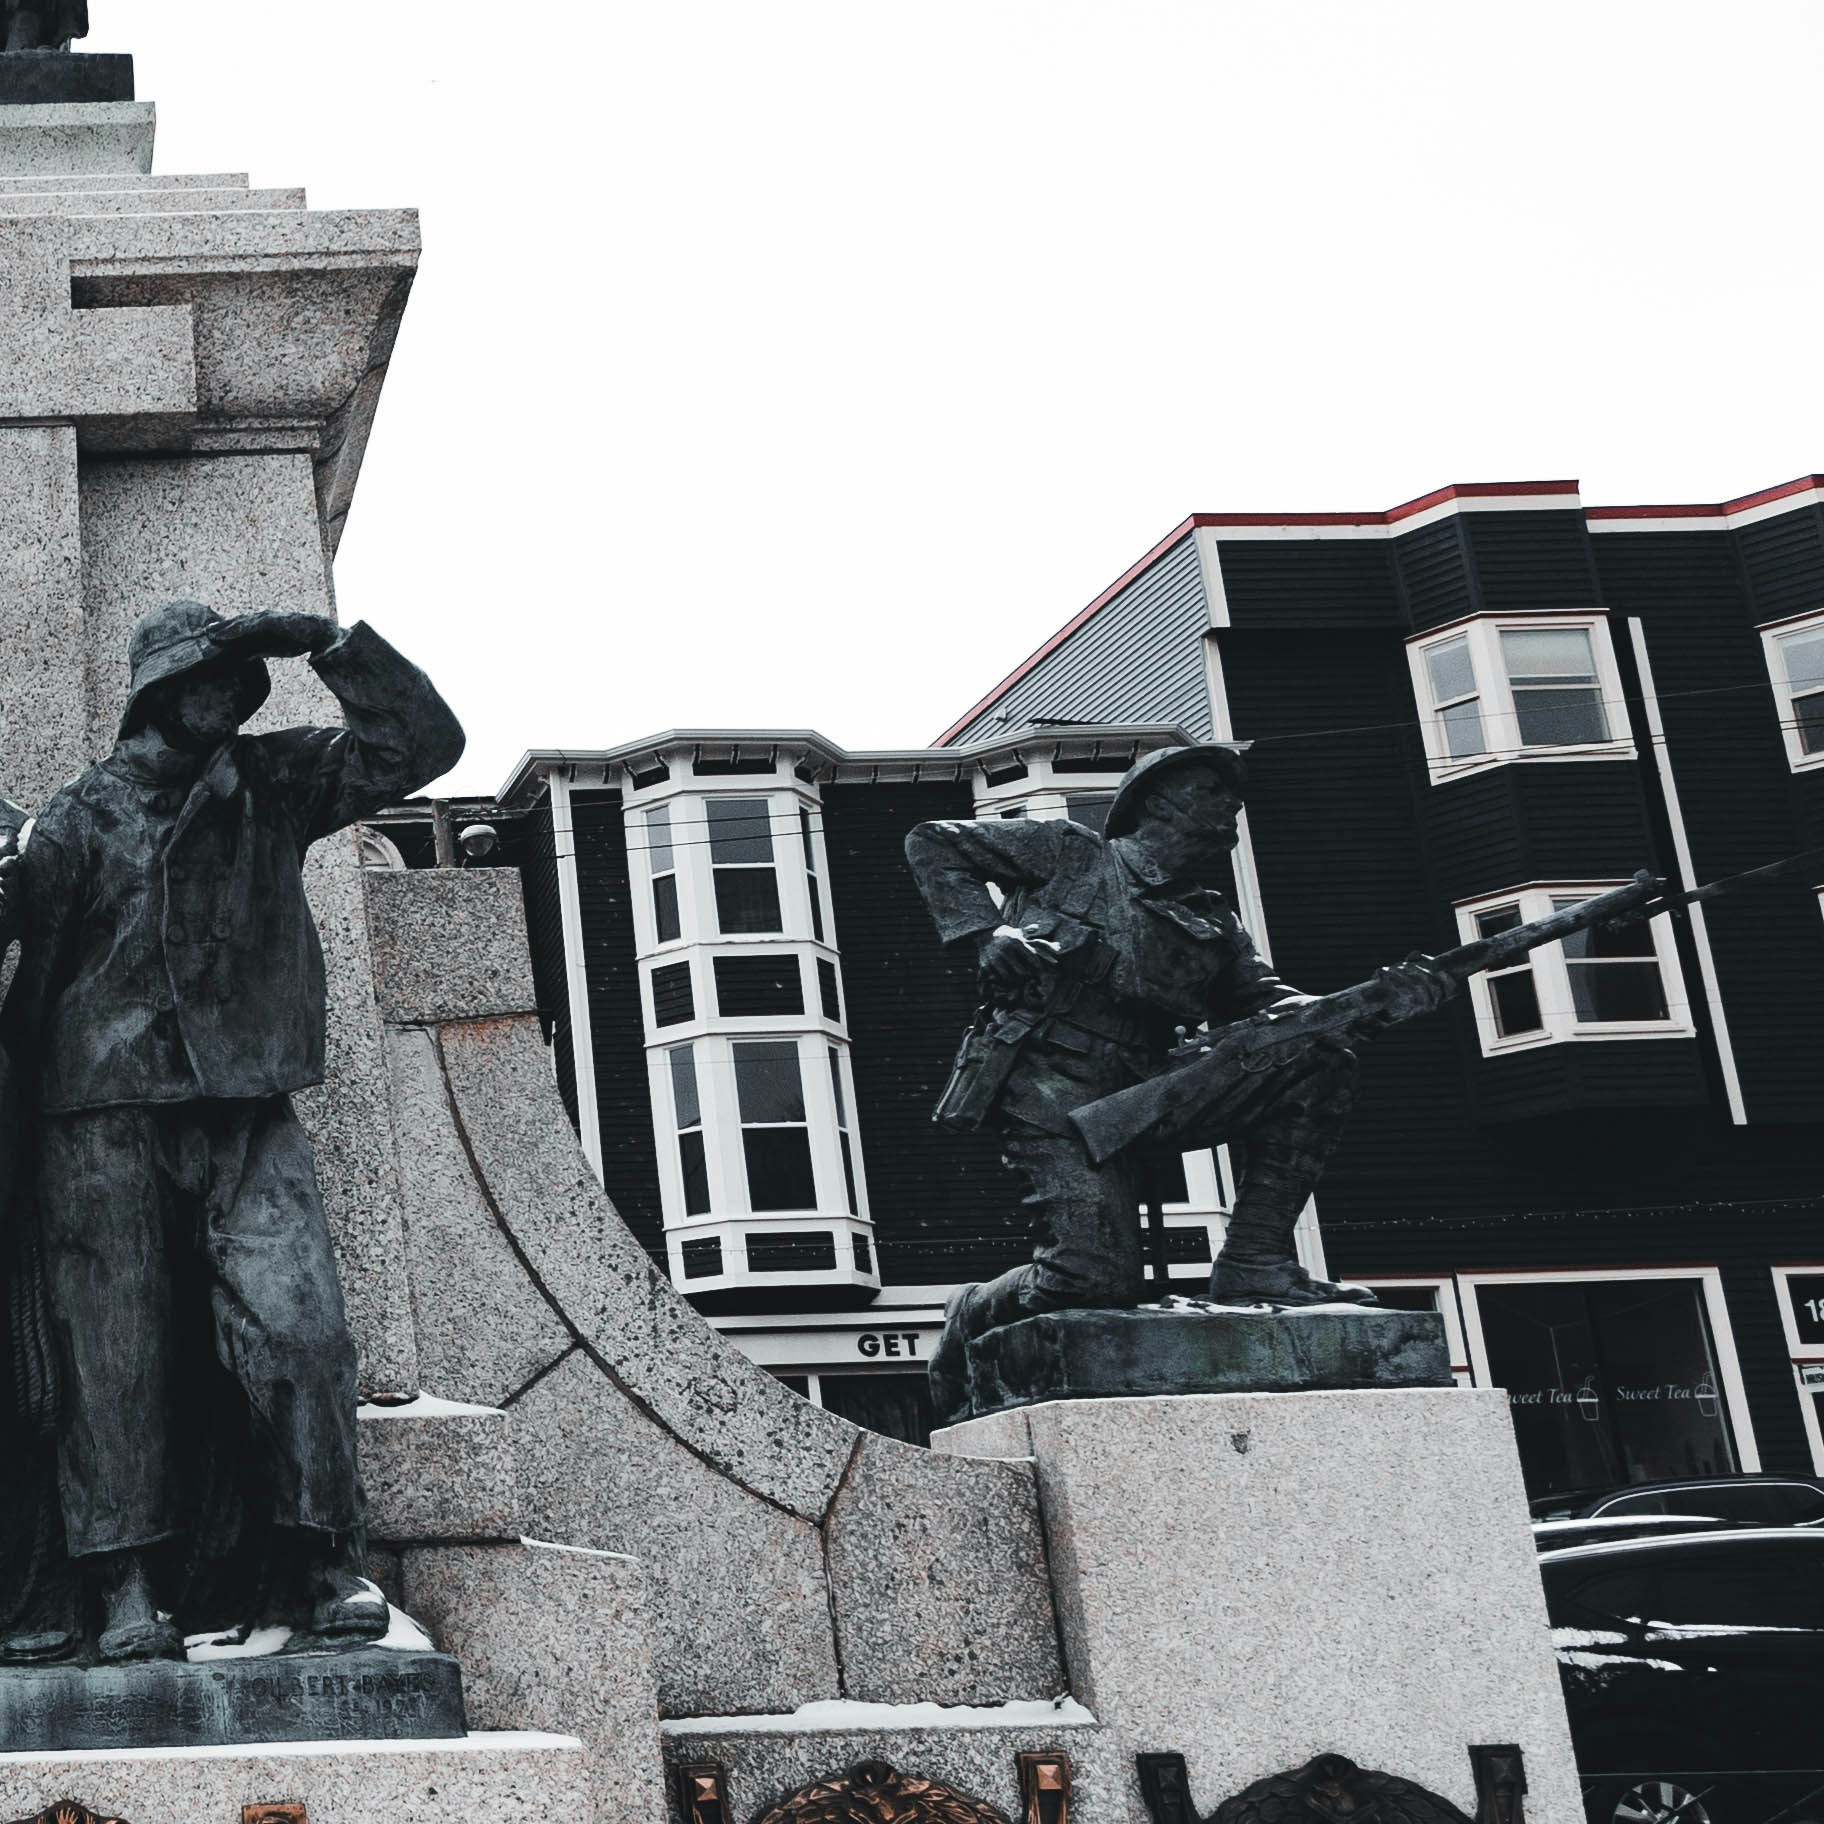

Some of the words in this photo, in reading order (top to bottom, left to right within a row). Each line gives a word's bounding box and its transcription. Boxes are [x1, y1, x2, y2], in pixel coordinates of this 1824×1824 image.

[858, 1333, 920, 1357] GET
[1508, 1389, 1543, 1405] weet
[1547, 1388, 1573, 1404] Tea
[1616, 1385, 1660, 1401] Sweet
[1664, 1383, 1691, 1399] Tea
